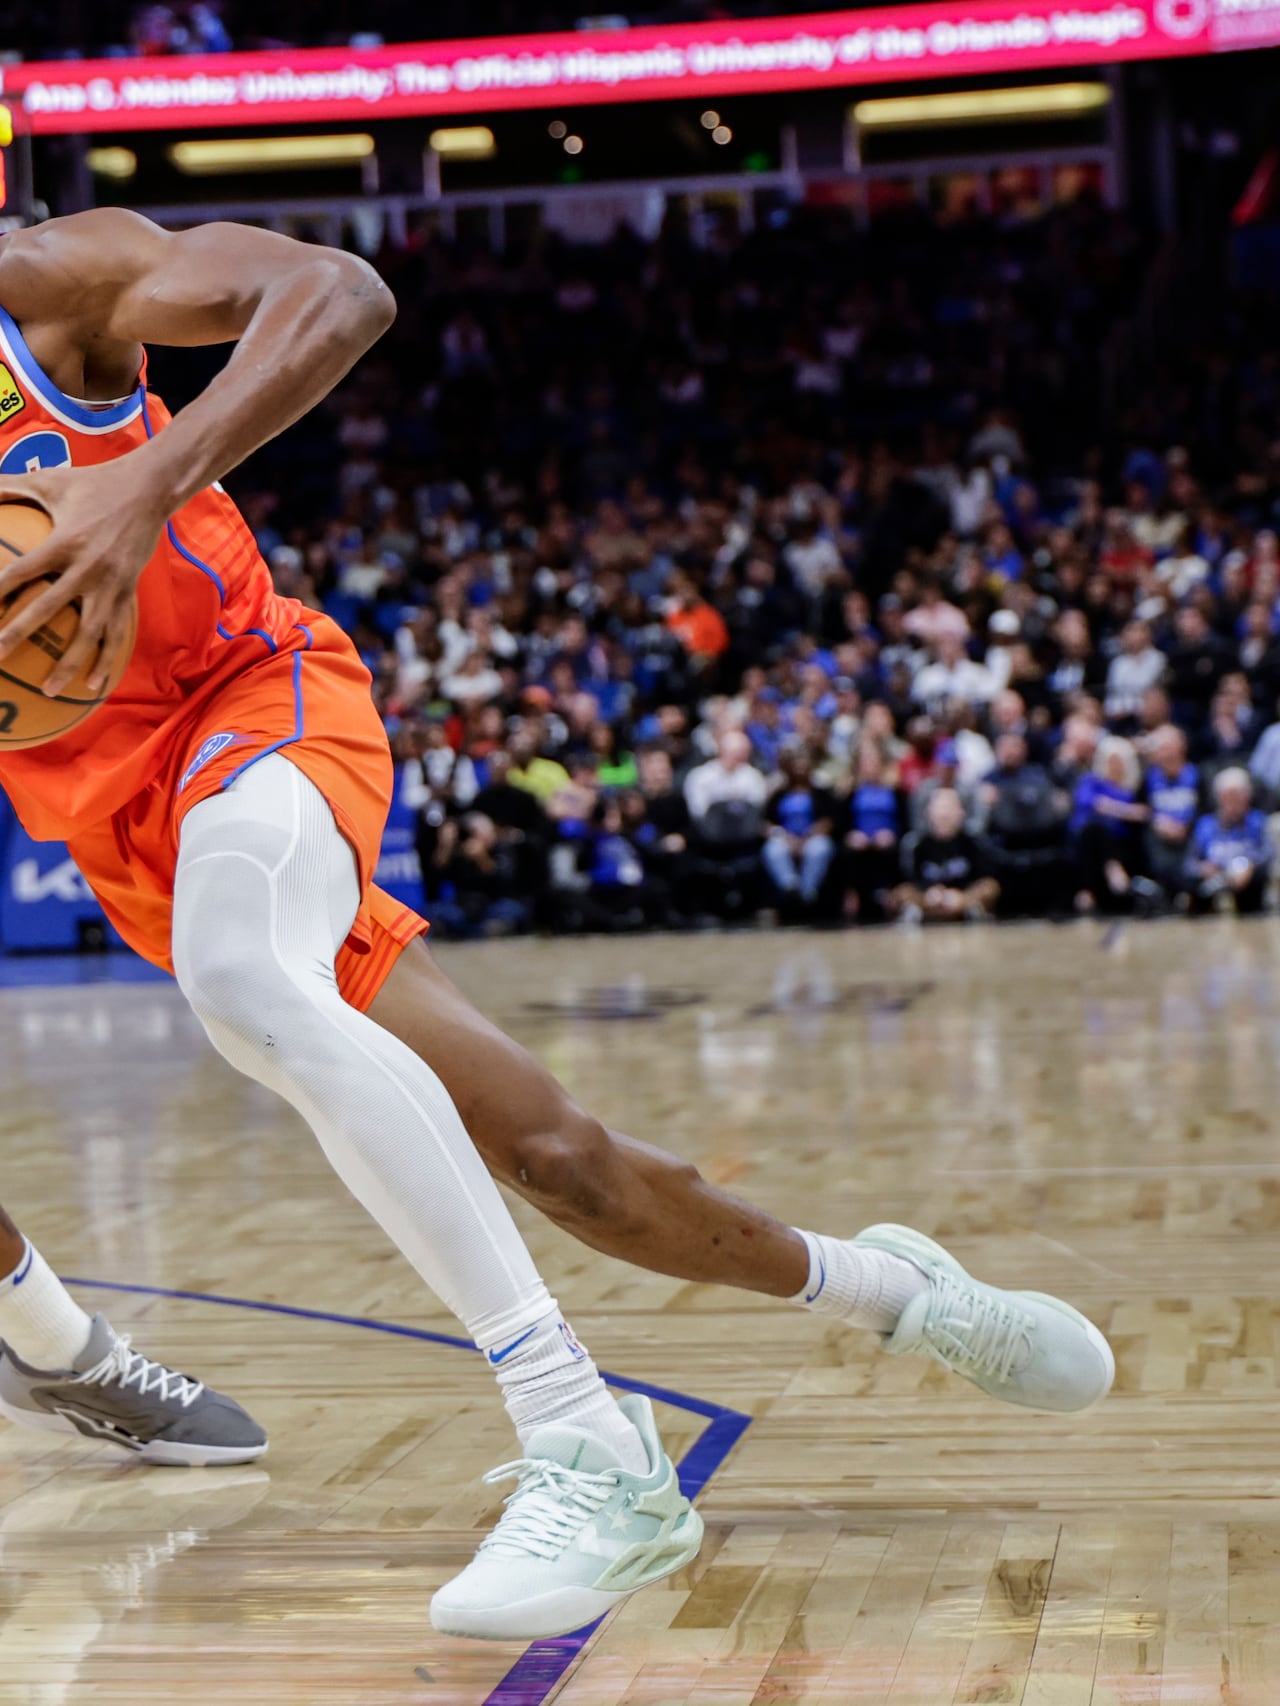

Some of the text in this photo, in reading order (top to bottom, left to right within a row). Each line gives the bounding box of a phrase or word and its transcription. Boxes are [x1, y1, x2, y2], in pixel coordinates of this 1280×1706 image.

[394, 62, 451, 95] The
[452, 52, 558, 91] Official
[559, 43, 686, 86] Hispanic
[687, 33, 836, 76] University
[837, 27, 870, 63] of
[871, 25, 925, 60] the
[926, 13, 1049, 55] Orlando
[1050, 4, 1146, 45] Magic
